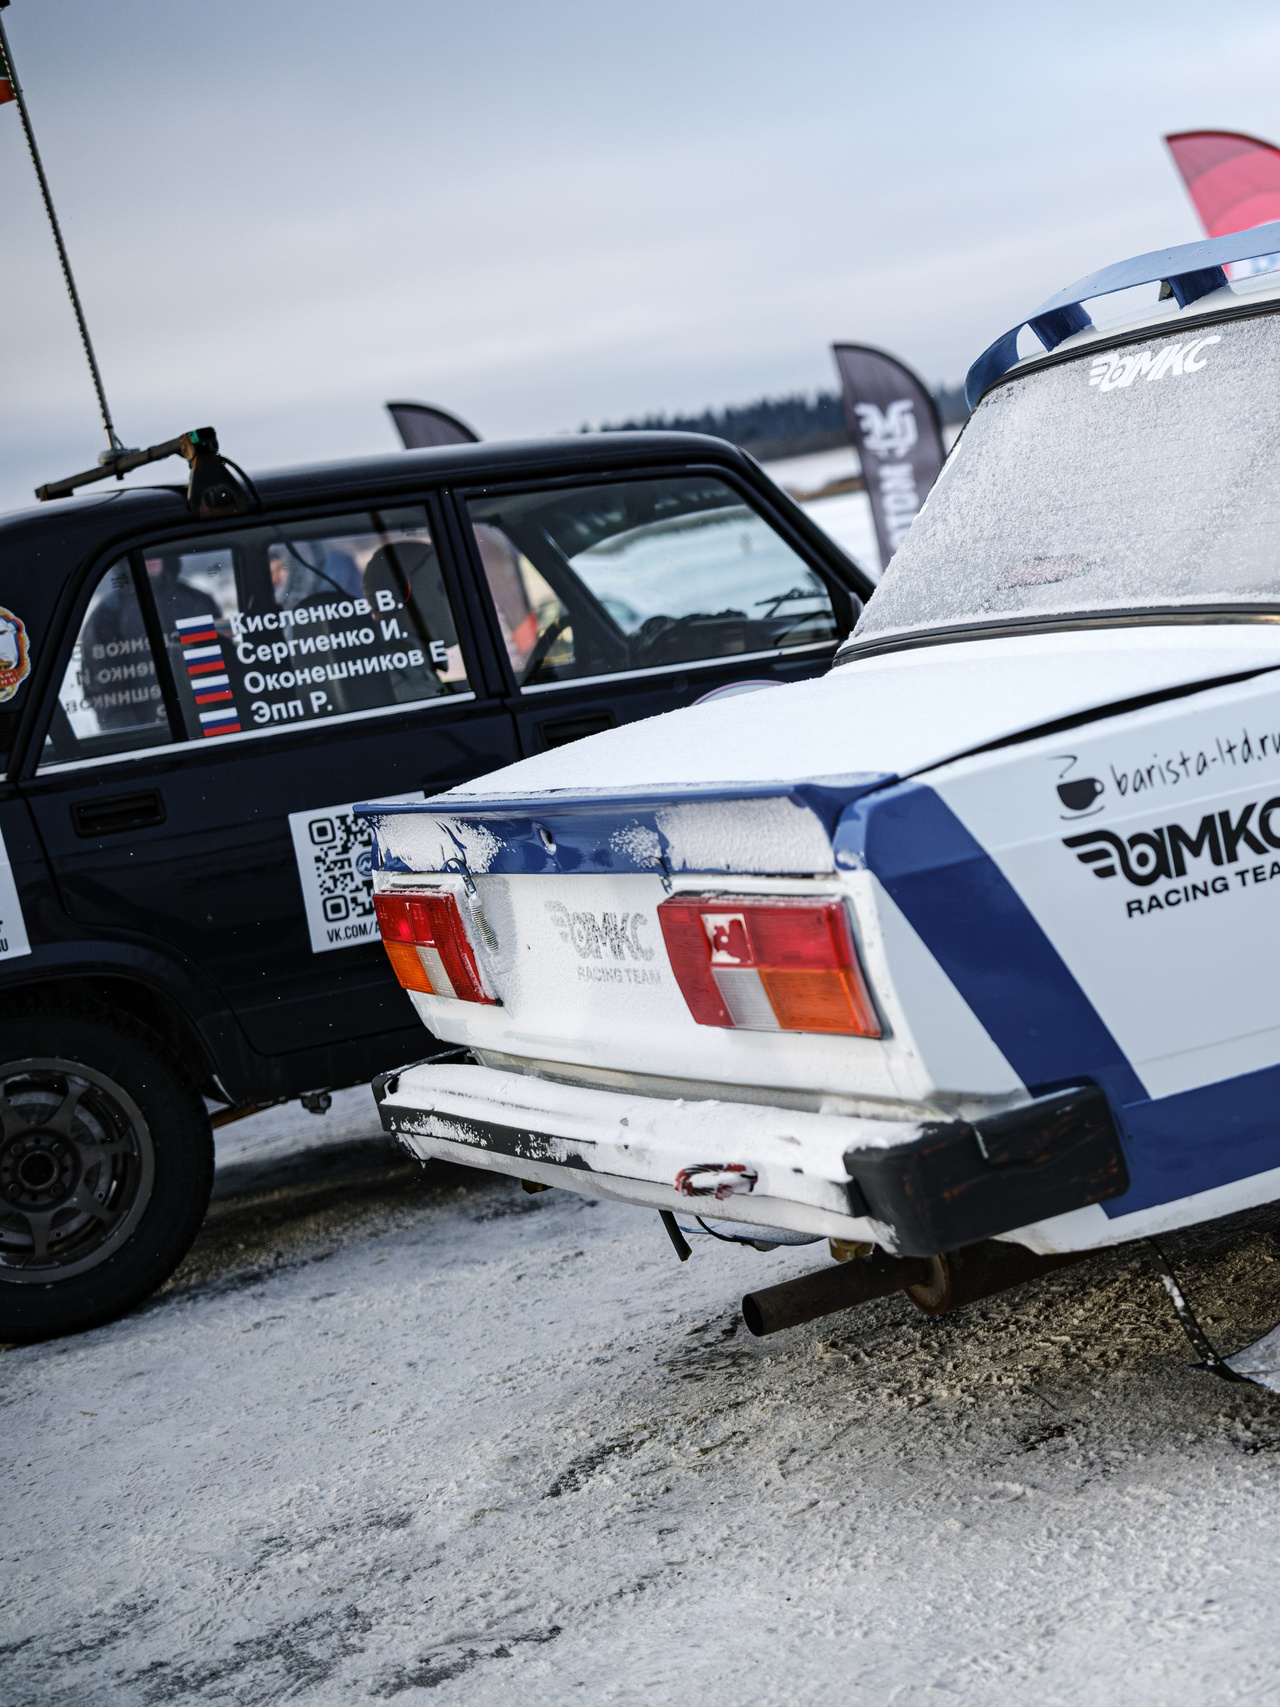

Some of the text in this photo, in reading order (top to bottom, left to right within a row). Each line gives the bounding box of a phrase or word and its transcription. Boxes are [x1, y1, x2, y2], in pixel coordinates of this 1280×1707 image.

[229, 590, 403, 635] Кисленков В.
[236, 618, 408, 665] Сергиенко И.
[244, 648, 424, 694] Оконешников
[250, 690, 333, 723] Эпп Р.
[1126, 876, 1230, 918] RACING
[578, 965, 661, 985] RACING TEAM
